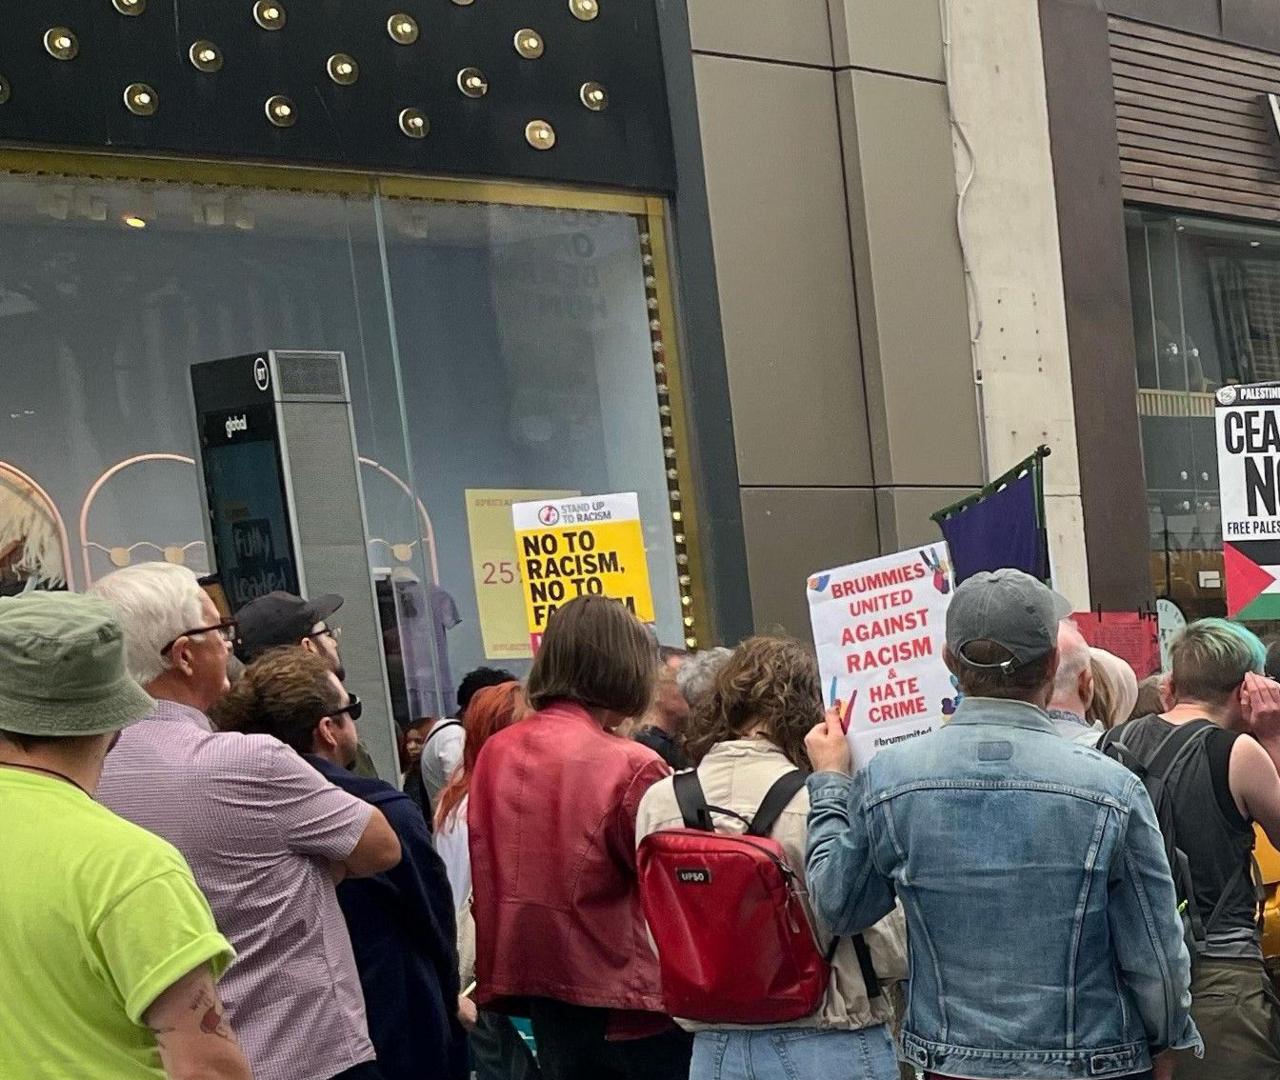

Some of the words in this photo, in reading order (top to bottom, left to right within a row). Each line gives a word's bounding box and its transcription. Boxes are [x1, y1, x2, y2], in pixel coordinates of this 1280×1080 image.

[226, 415, 247, 438] global
[561, 503, 590, 514] STAND
[592, 501, 605, 511] UP
[562, 514, 575, 523] TO
[577, 511, 612, 523] RACISM
[1227, 522, 1250, 535] FREE
[523, 534, 558, 557] NO
[563, 531, 595, 553] TO
[527, 551, 626, 580] RACISM,
[530, 579, 565, 602] NO
[572, 576, 603, 600] TO
[831, 562, 926, 599] BRUMMIES
[850, 589, 913, 617] UNITED
[841, 608, 929, 646] AGAINST
[846, 636, 932, 674] RACISM
[887, 668, 897, 680] &
[869, 677, 919, 702] HATE
[868, 696, 927, 724] CRIME
